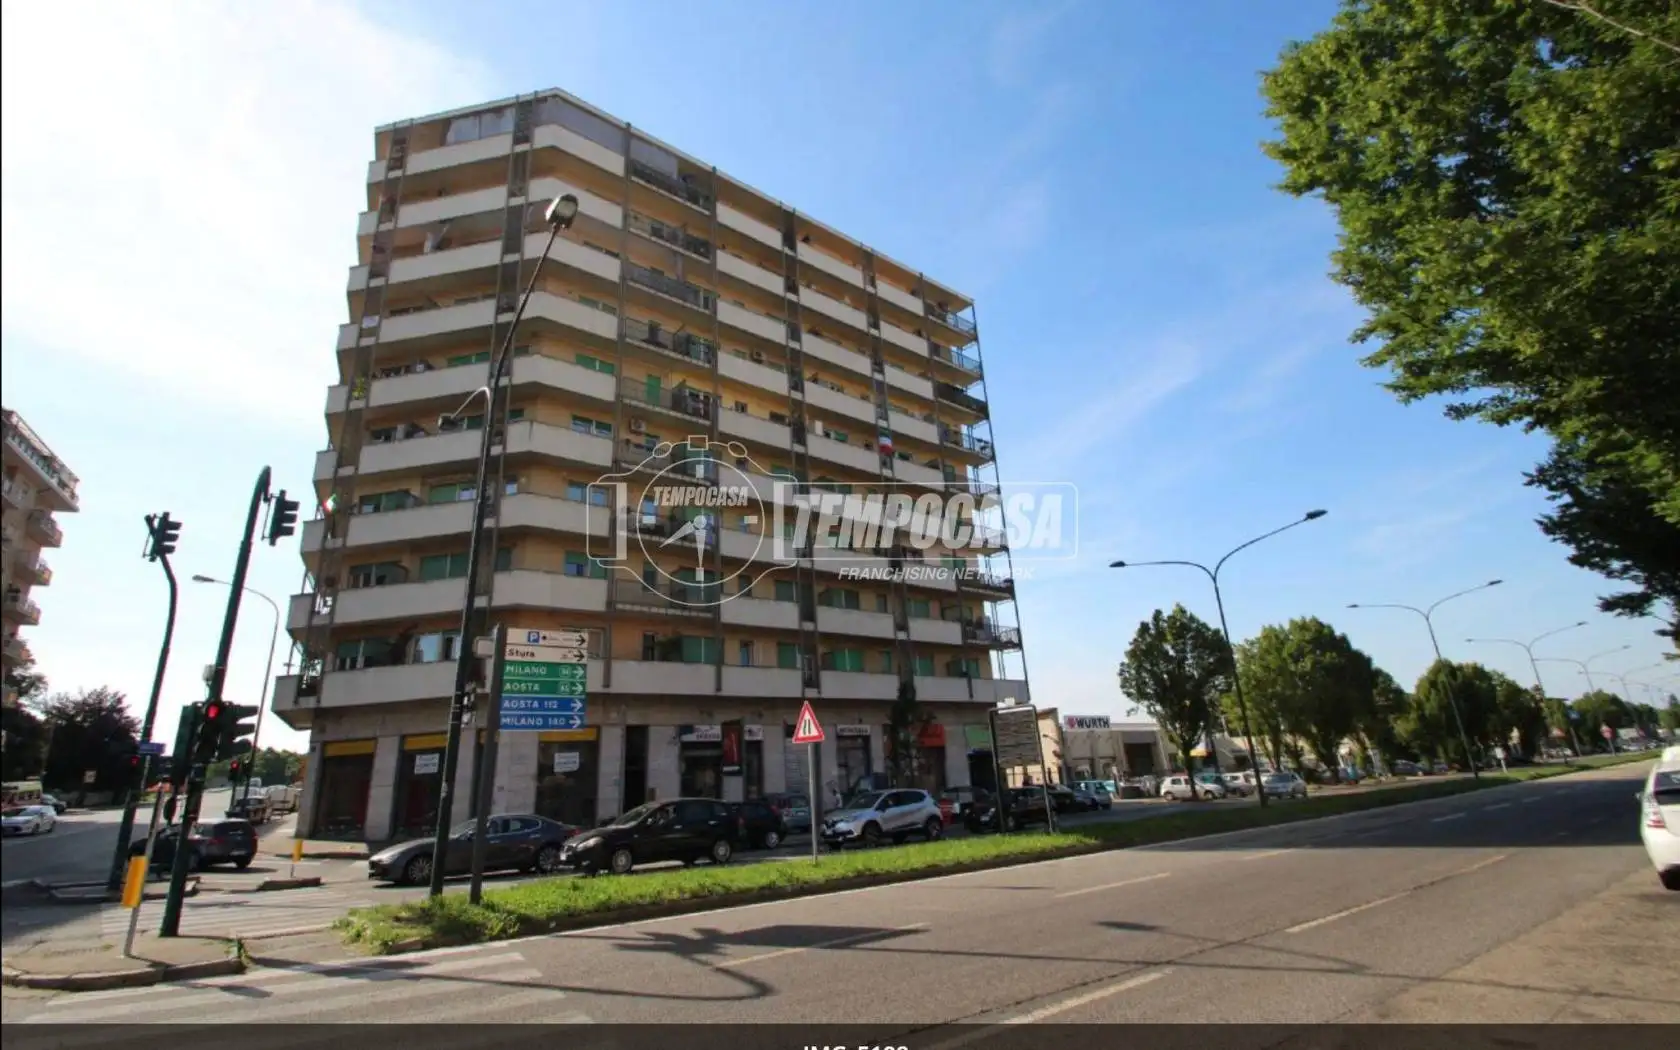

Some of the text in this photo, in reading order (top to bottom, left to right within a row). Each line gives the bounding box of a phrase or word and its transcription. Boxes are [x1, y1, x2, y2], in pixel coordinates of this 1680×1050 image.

[507, 648, 535, 658] Stura
[505, 664, 547, 675] MILANO
[503, 682, 540, 692] AOSTA
[503, 700, 539, 708] AOSTA
[501, 717, 543, 726] MILANO
